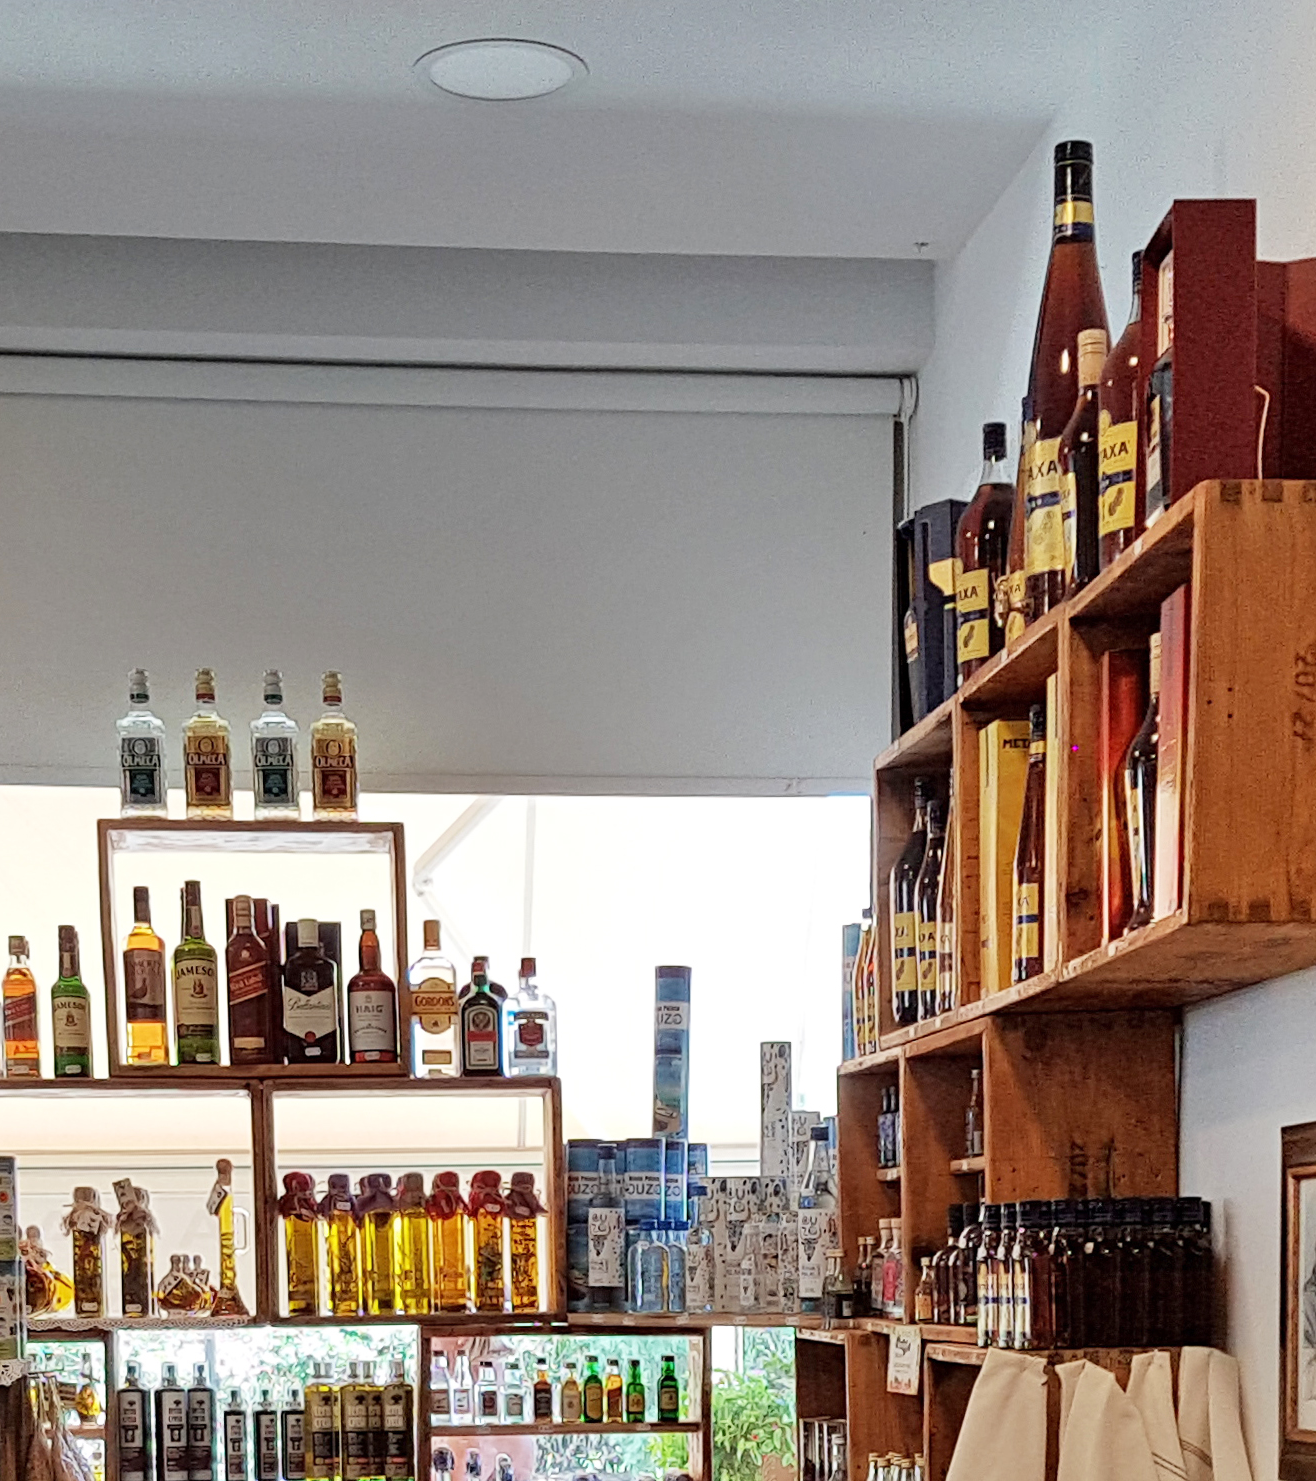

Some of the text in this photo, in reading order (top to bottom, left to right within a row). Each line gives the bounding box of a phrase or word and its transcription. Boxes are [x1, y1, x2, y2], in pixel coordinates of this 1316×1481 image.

[121, 754, 160, 768] OLMECA
[187, 753, 226, 766] OLMECA
[255, 753, 293, 767] OLMECA
[315, 755, 353, 769] OLMECA
